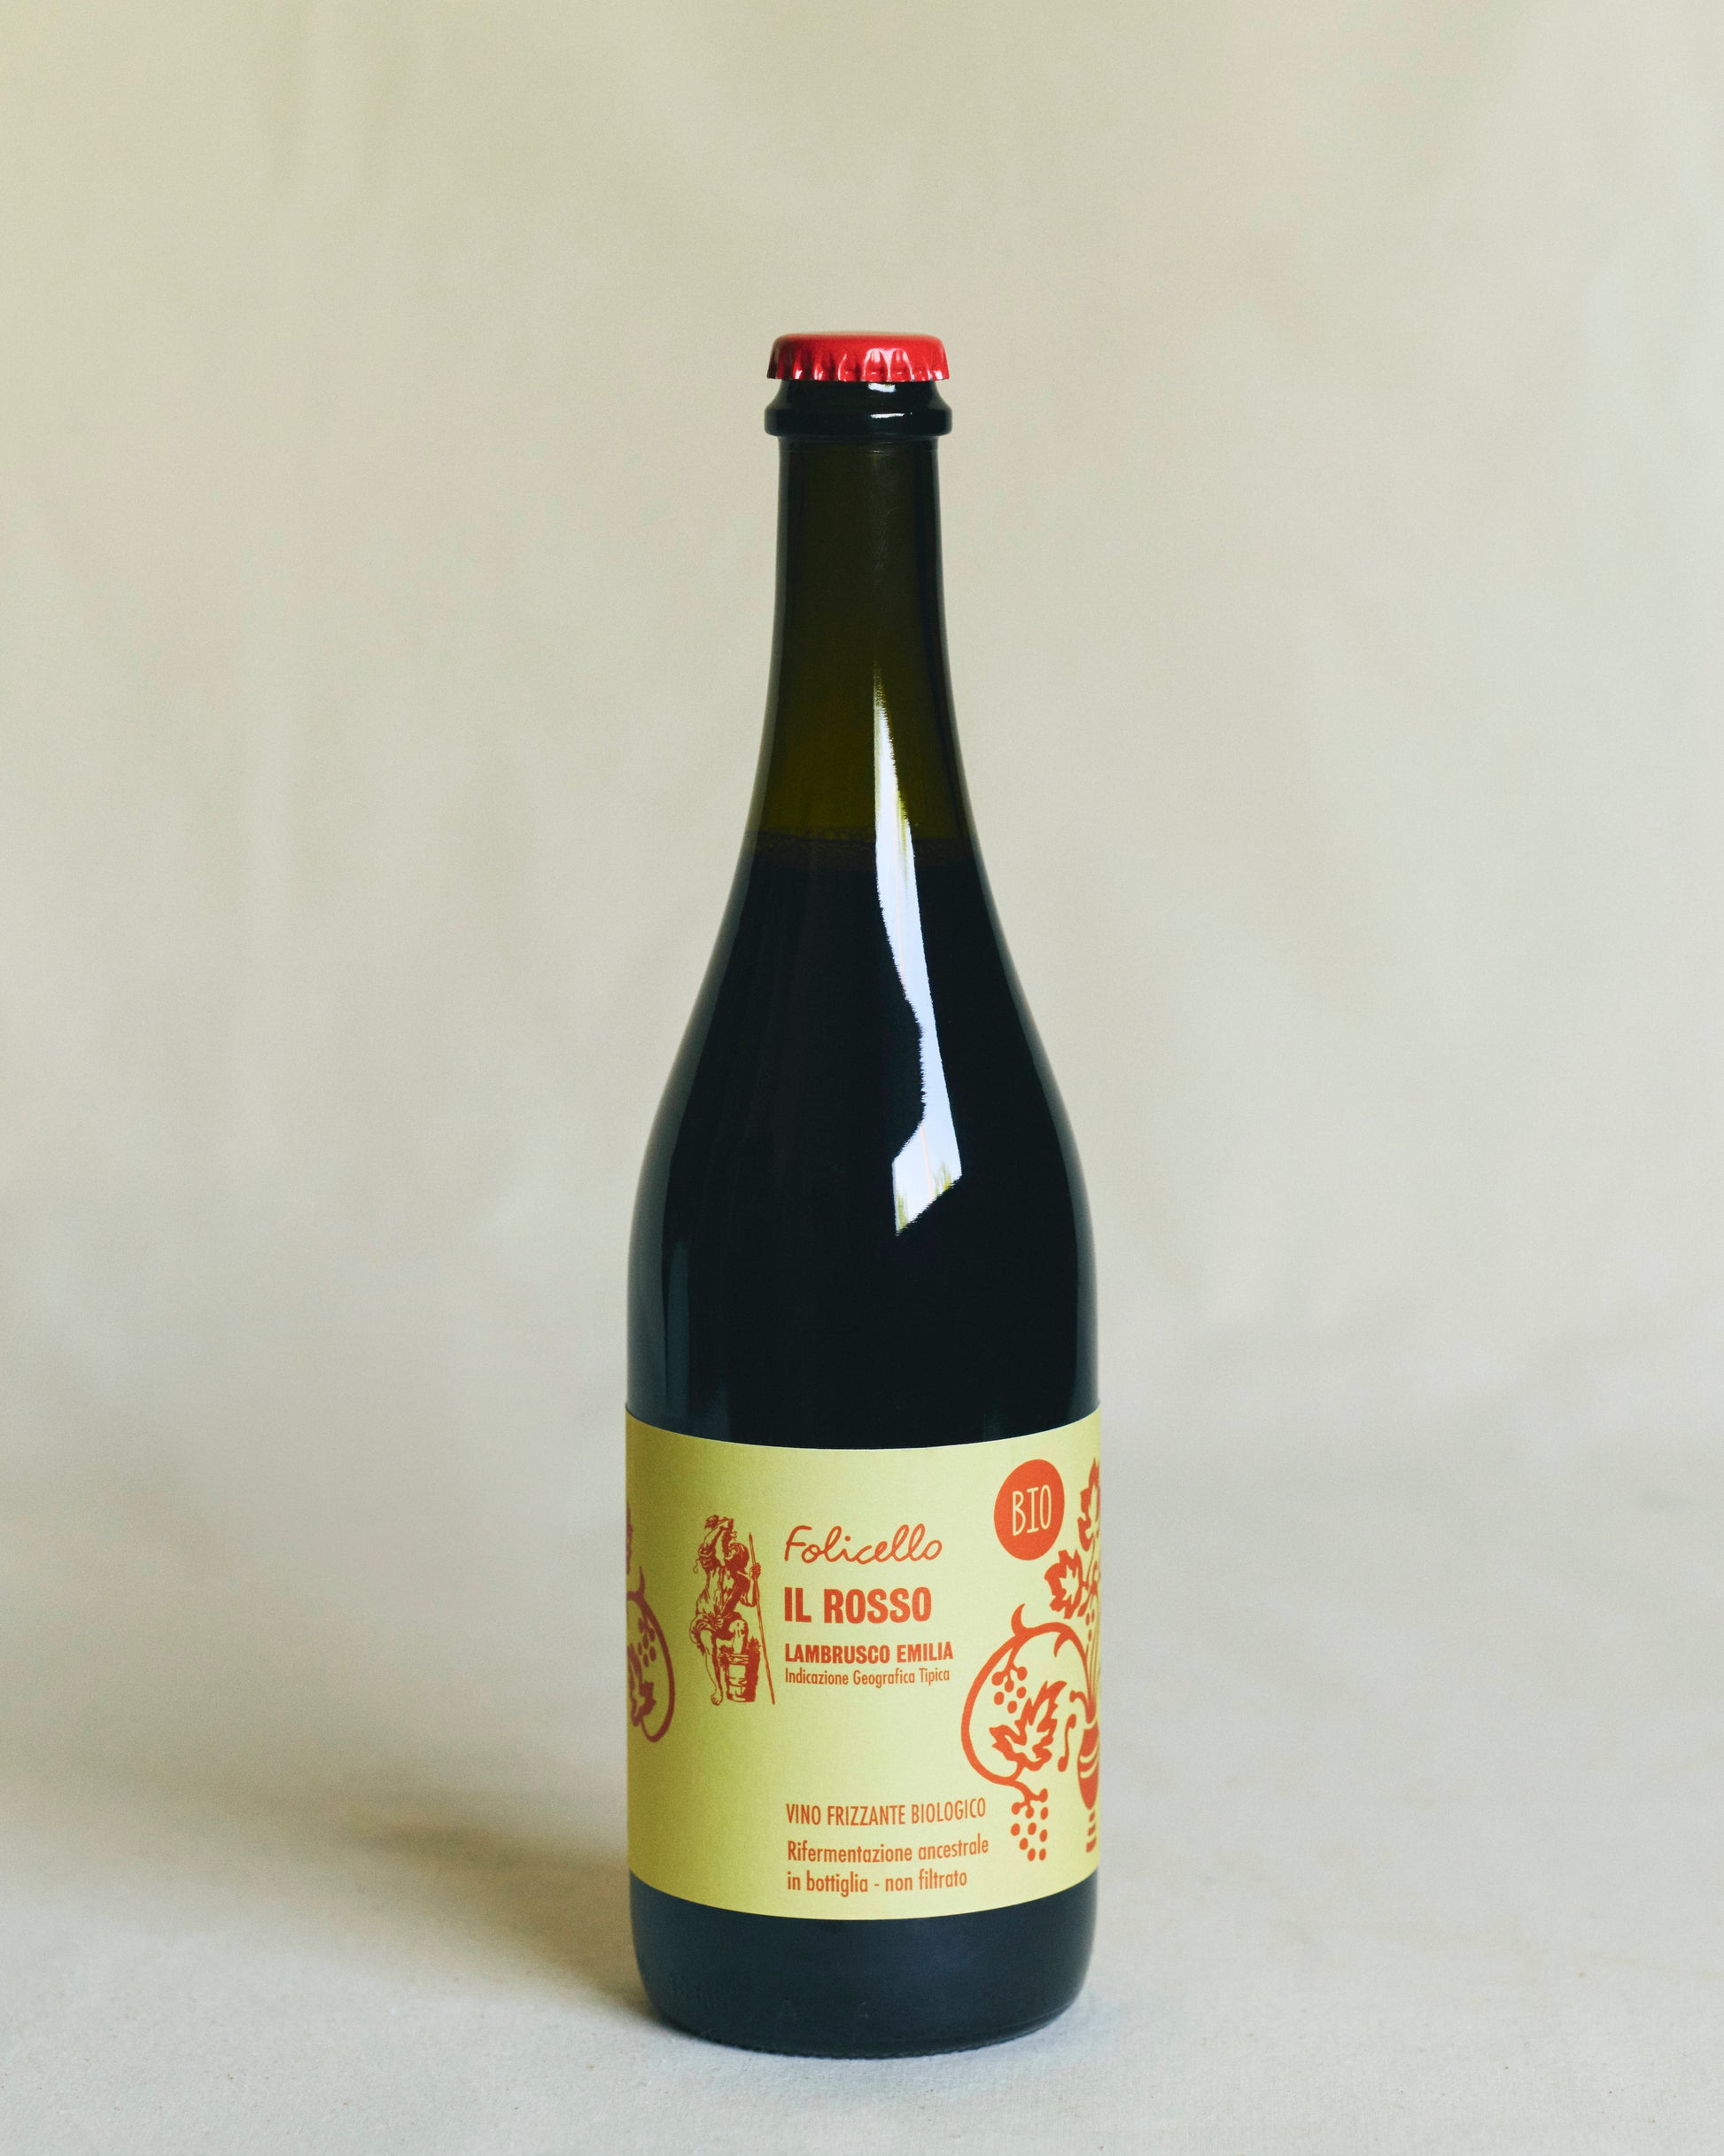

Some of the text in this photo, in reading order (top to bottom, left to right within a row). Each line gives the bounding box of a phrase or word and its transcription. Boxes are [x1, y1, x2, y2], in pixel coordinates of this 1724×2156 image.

[1013, 1484, 1052, 1537] BIO
[785, 1523, 944, 1566] Folicello
[785, 1587, 933, 1624] IL ROSSO
[786, 1642, 954, 1665] LAMBRUSCO EMILIA
[786, 1667, 951, 1689] Indicazione Geografica Tipica
[786, 1797, 987, 1826] VINO FRIZZANTE BIOLOGICO
[788, 1833, 989, 1864] Rifermentazione ancestrale
[788, 1871, 802, 1891] in
[807, 1870, 869, 1898] bottiglia
[886, 1877, 914, 1892] non
[919, 1868, 967, 1890] filtrato
